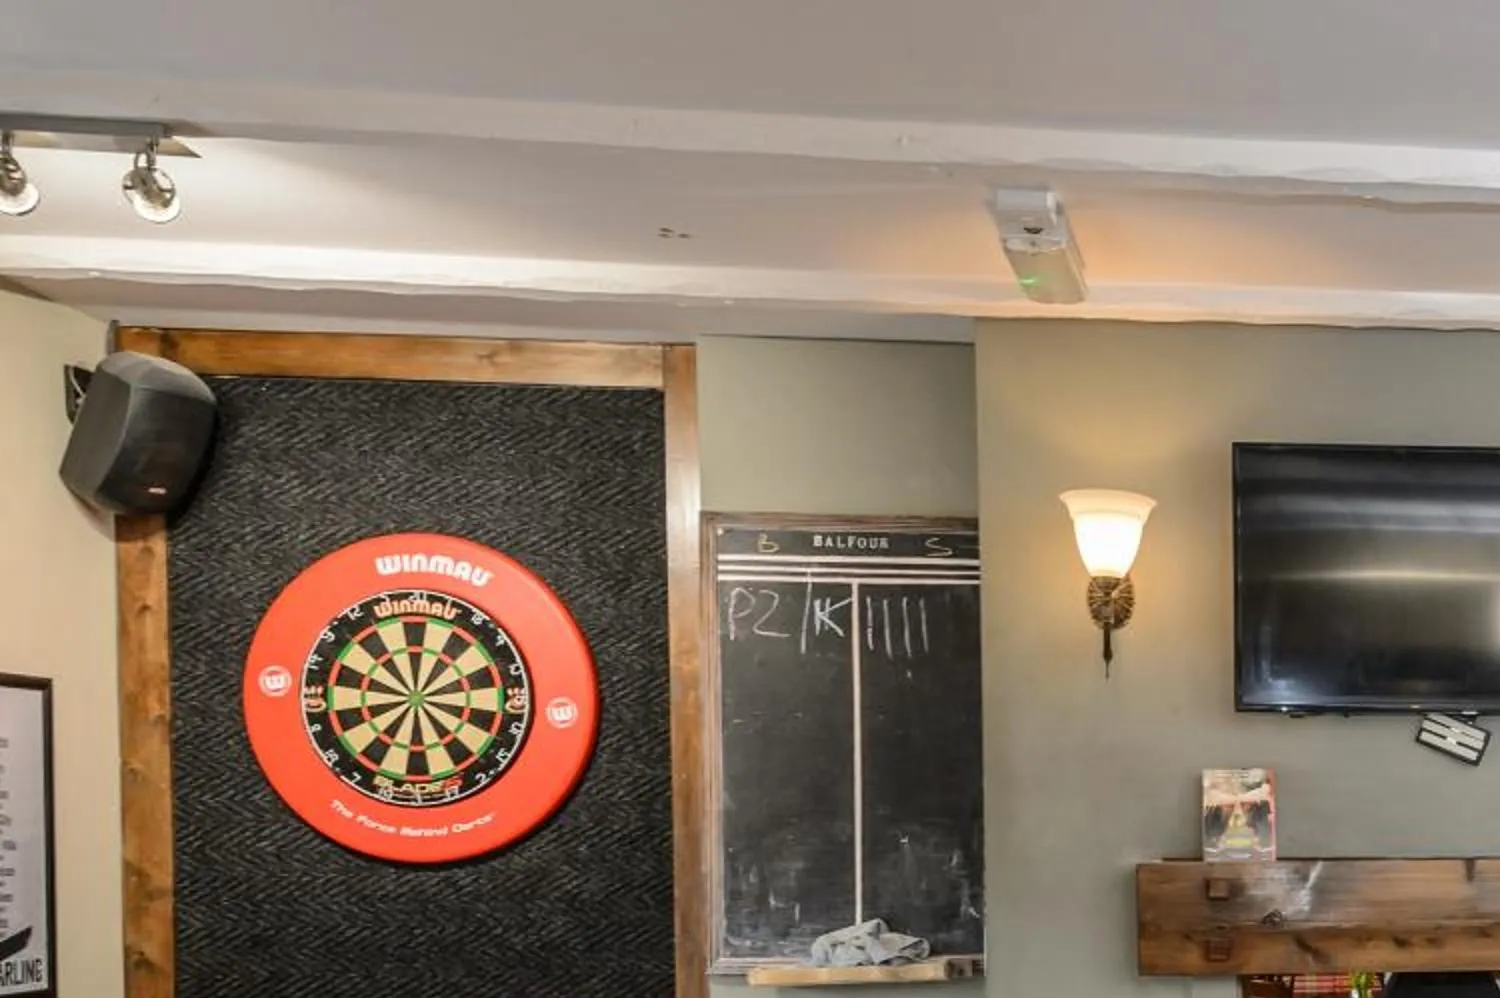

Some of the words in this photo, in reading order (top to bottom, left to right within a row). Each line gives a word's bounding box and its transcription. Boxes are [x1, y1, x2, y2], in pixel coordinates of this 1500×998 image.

[757, 534, 780, 553] B
[813, 535, 889, 549] BALFOUR
[375, 553, 494, 588] WINMAU
[373, 600, 463, 620] WINMAU
